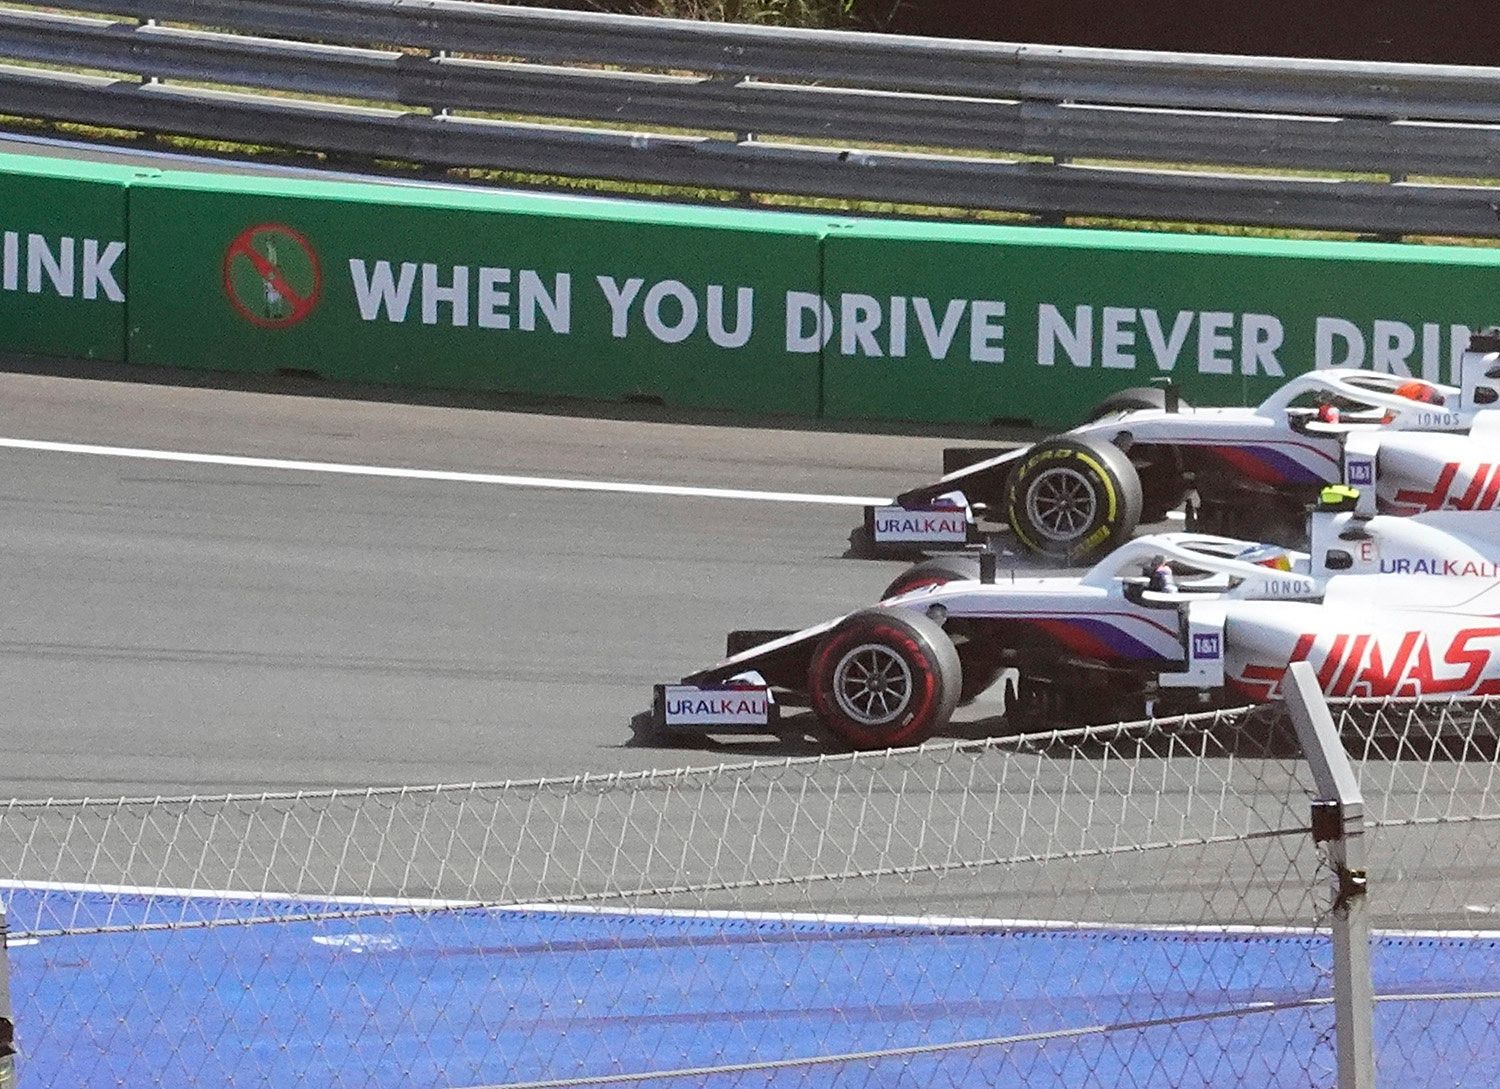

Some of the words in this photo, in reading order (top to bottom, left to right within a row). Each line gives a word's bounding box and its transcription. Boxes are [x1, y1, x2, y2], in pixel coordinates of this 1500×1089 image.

[3, 231, 126, 303] INK
[349, 259, 571, 334] WHEN
[597, 275, 754, 349] YOU
[785, 291, 1006, 363] DRIVE
[1037, 303, 1286, 377] NEVER
[1417, 412, 1461, 427] IONOS
[876, 516, 966, 534] URALKALI
[1380, 558, 1499, 578] URALKALI
[1263, 579, 1313, 595] IONOS
[666, 699, 768, 716] URALKALI
